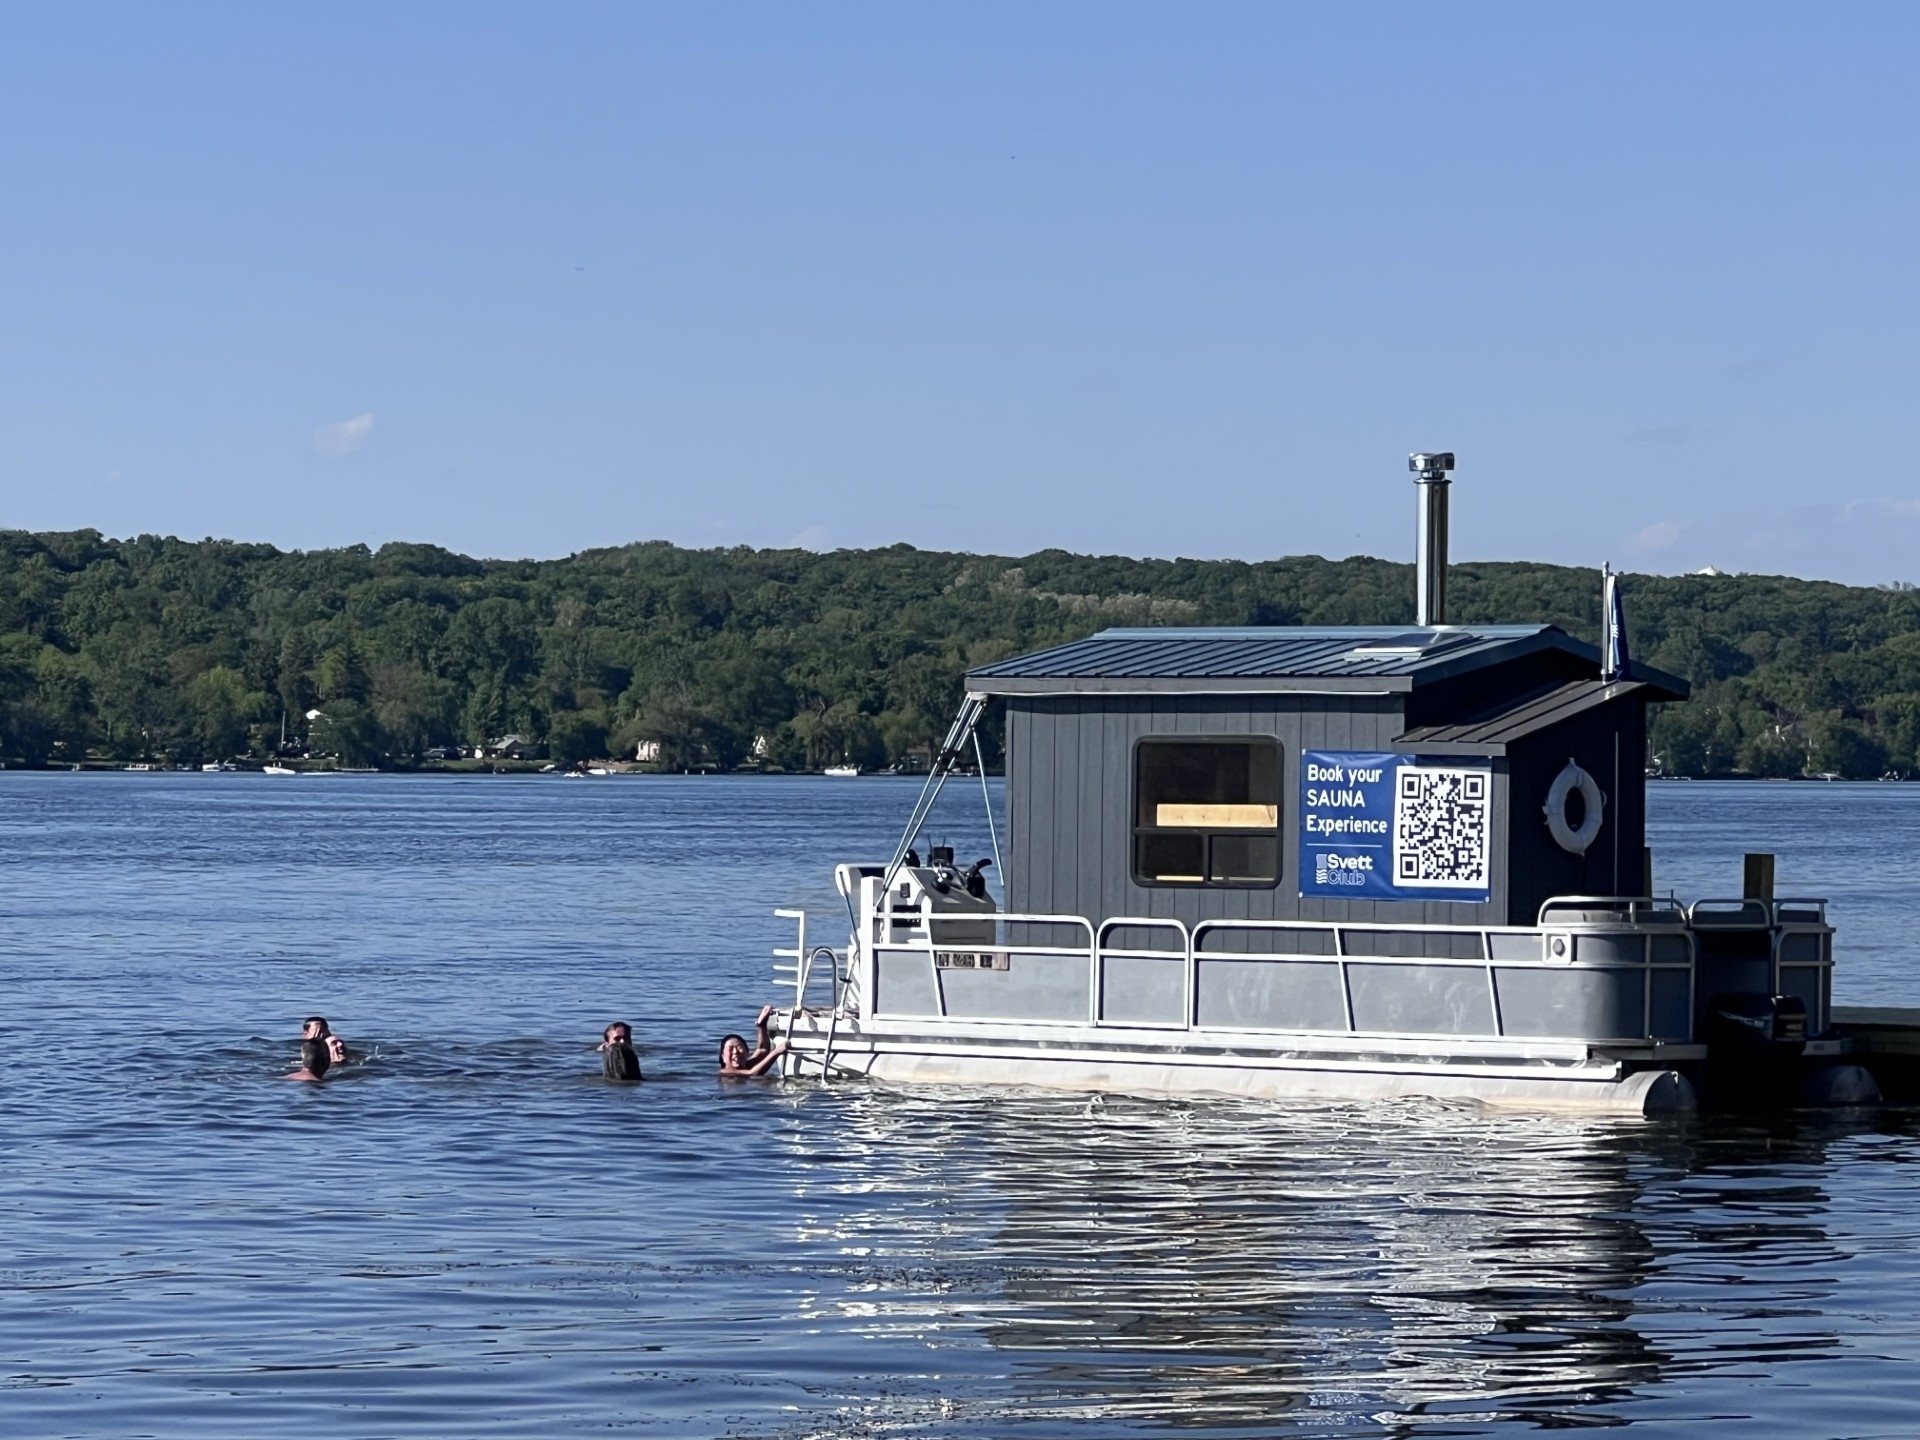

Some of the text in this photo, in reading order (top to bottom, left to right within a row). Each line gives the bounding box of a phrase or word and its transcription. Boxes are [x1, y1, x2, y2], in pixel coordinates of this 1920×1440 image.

[1308, 764, 1383, 787] Book your
[1307, 789, 1366, 807] SAUNA
[1306, 814, 1388, 837] Experience
[1327, 853, 1373, 870] Svett
[1327, 869, 1366, 886] Club
